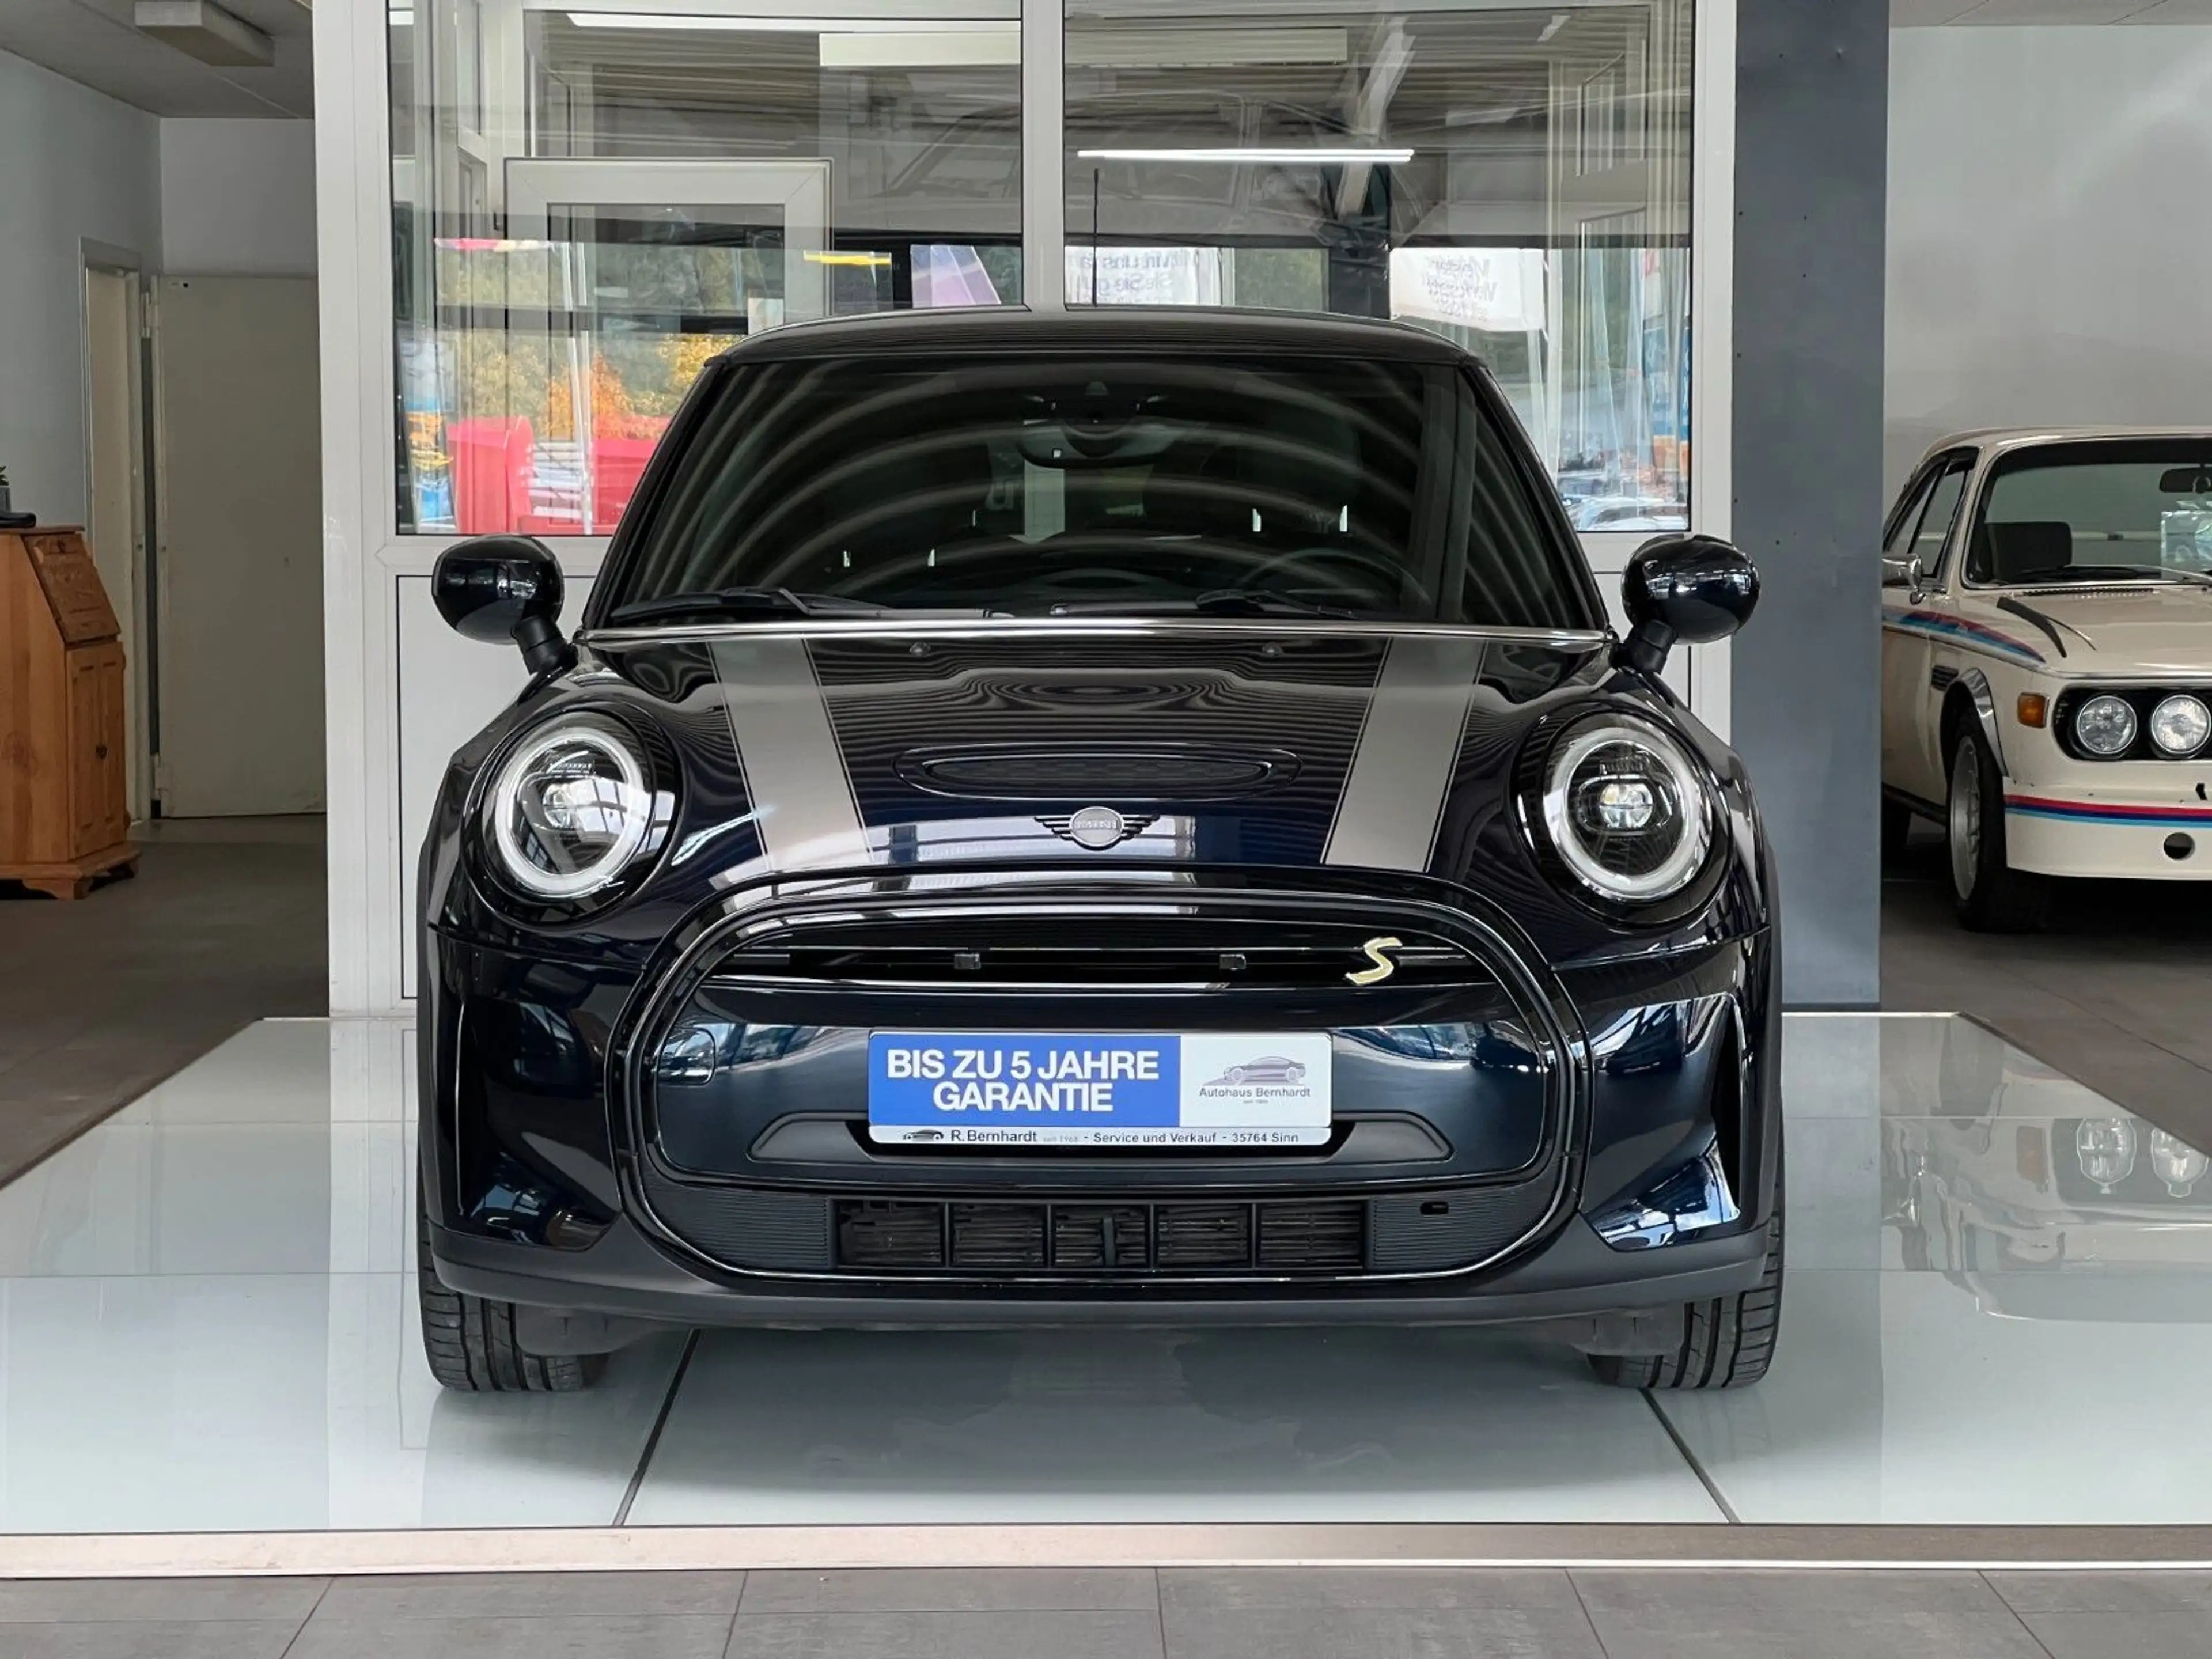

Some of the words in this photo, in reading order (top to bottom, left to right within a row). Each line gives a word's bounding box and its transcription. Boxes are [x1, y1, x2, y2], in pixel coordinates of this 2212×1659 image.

[1074, 820, 1118, 830] MINI
[1345, 937, 1403, 985] S
[887, 1049, 945, 1079] BIS
[952, 1050, 1002, 1079] ZU
[1010, 1050, 1031, 1080] 5
[1037, 1051, 1159, 1080] JAHRE
[933, 1081, 1113, 1111] GARANTIE
[1199, 1087, 1252, 1097] Autohaus
[1256, 1086, 1310, 1097] Bernhardt
[968, 1129, 1037, 1142] Bernhardt
[1093, 1132, 1139, 1143] Service
[1143, 1132, 1166, 1143] und
[1171, 1132, 1217, 1143] Verkauf
[1232, 1133, 1267, 1143] 35764
[1271, 1132, 1299, 1143] Sinn
